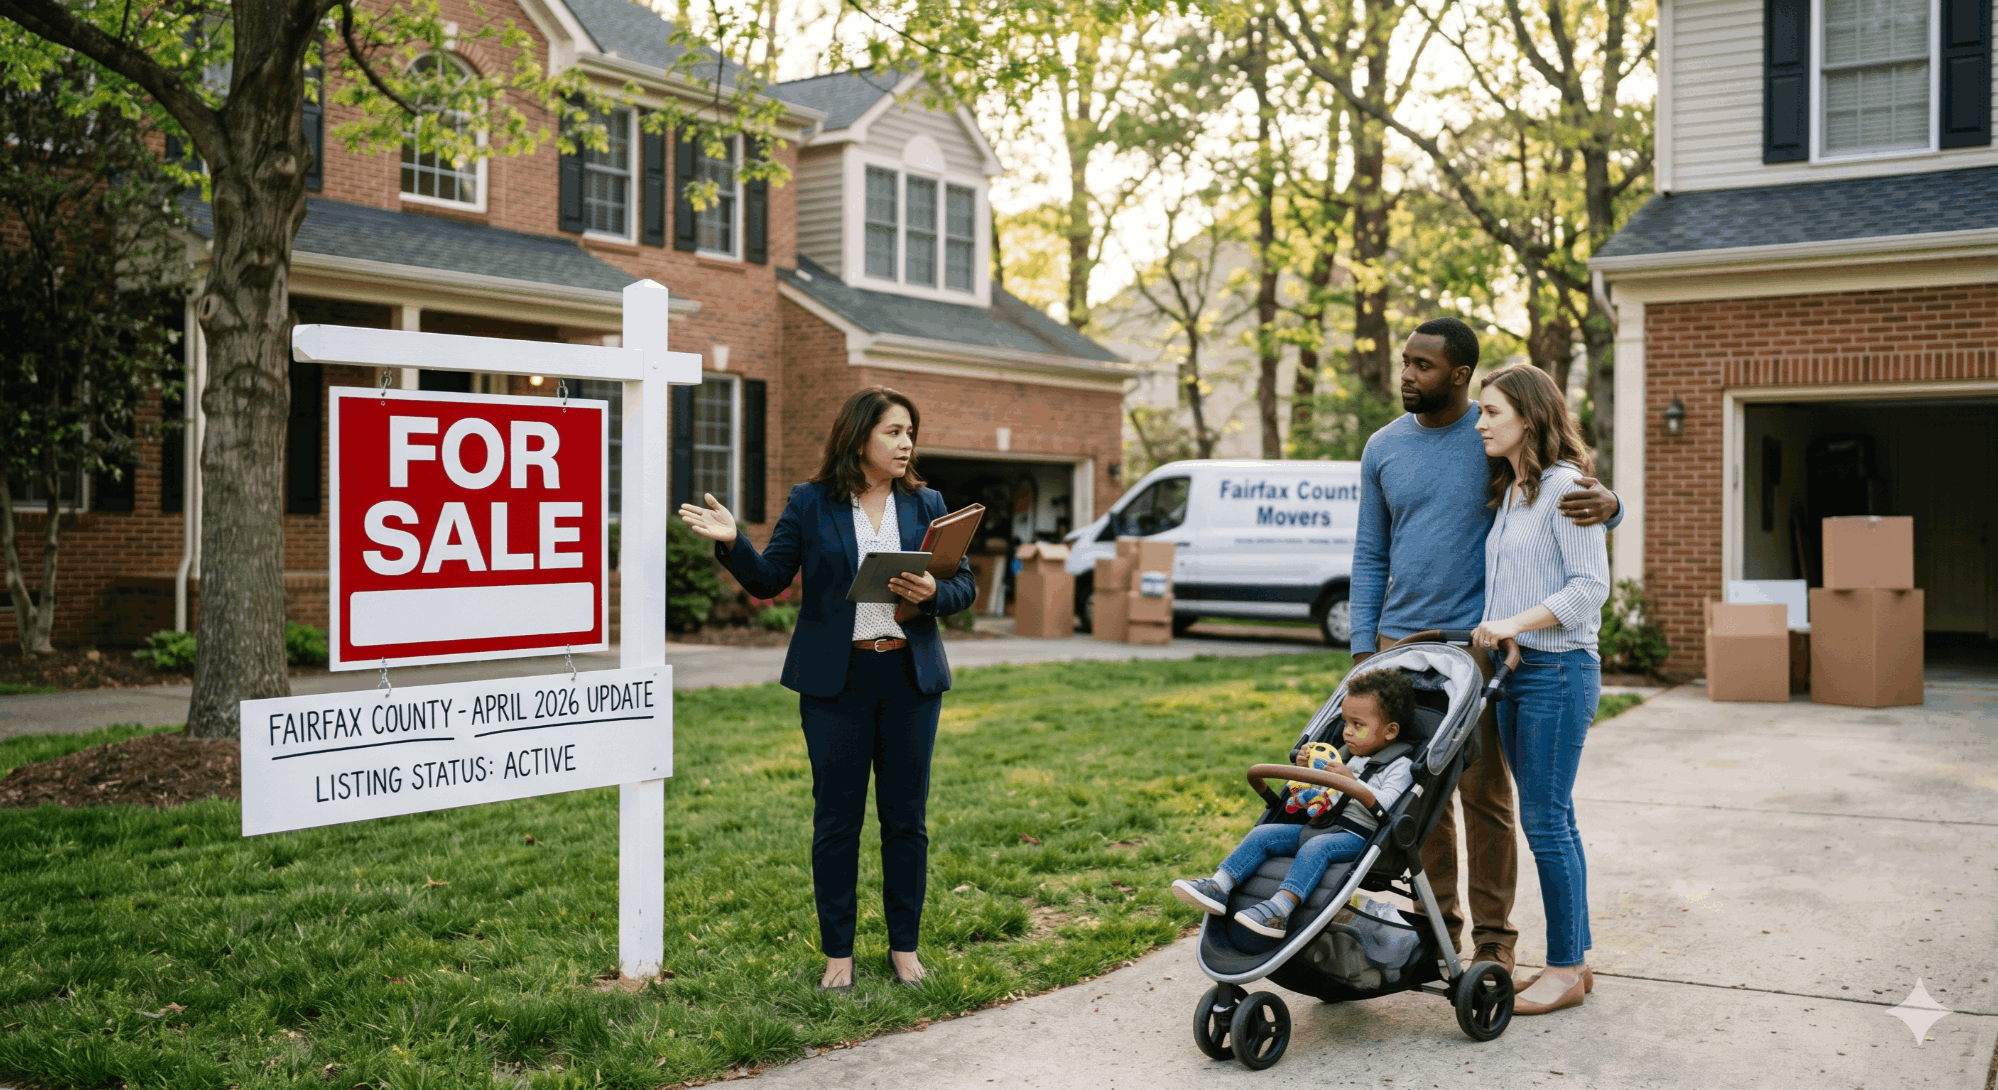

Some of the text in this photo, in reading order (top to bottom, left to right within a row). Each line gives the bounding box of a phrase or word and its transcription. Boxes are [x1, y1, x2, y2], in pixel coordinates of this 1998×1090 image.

[390, 415, 561, 490] FOR
[1220, 479, 1361, 500] Fairfax Count
[1257, 505, 1332, 527] Movers
[363, 500, 584, 576] SALE
[269, 707, 362, 747] FAIRFAX
[372, 698, 453, 736] COUNTY
[471, 692, 528, 726] APRIL
[534, 687, 581, 720] 2026
[587, 680, 655, 714] UPDATE
[316, 744, 577, 803] LISTING STATUS: ACTIVE
